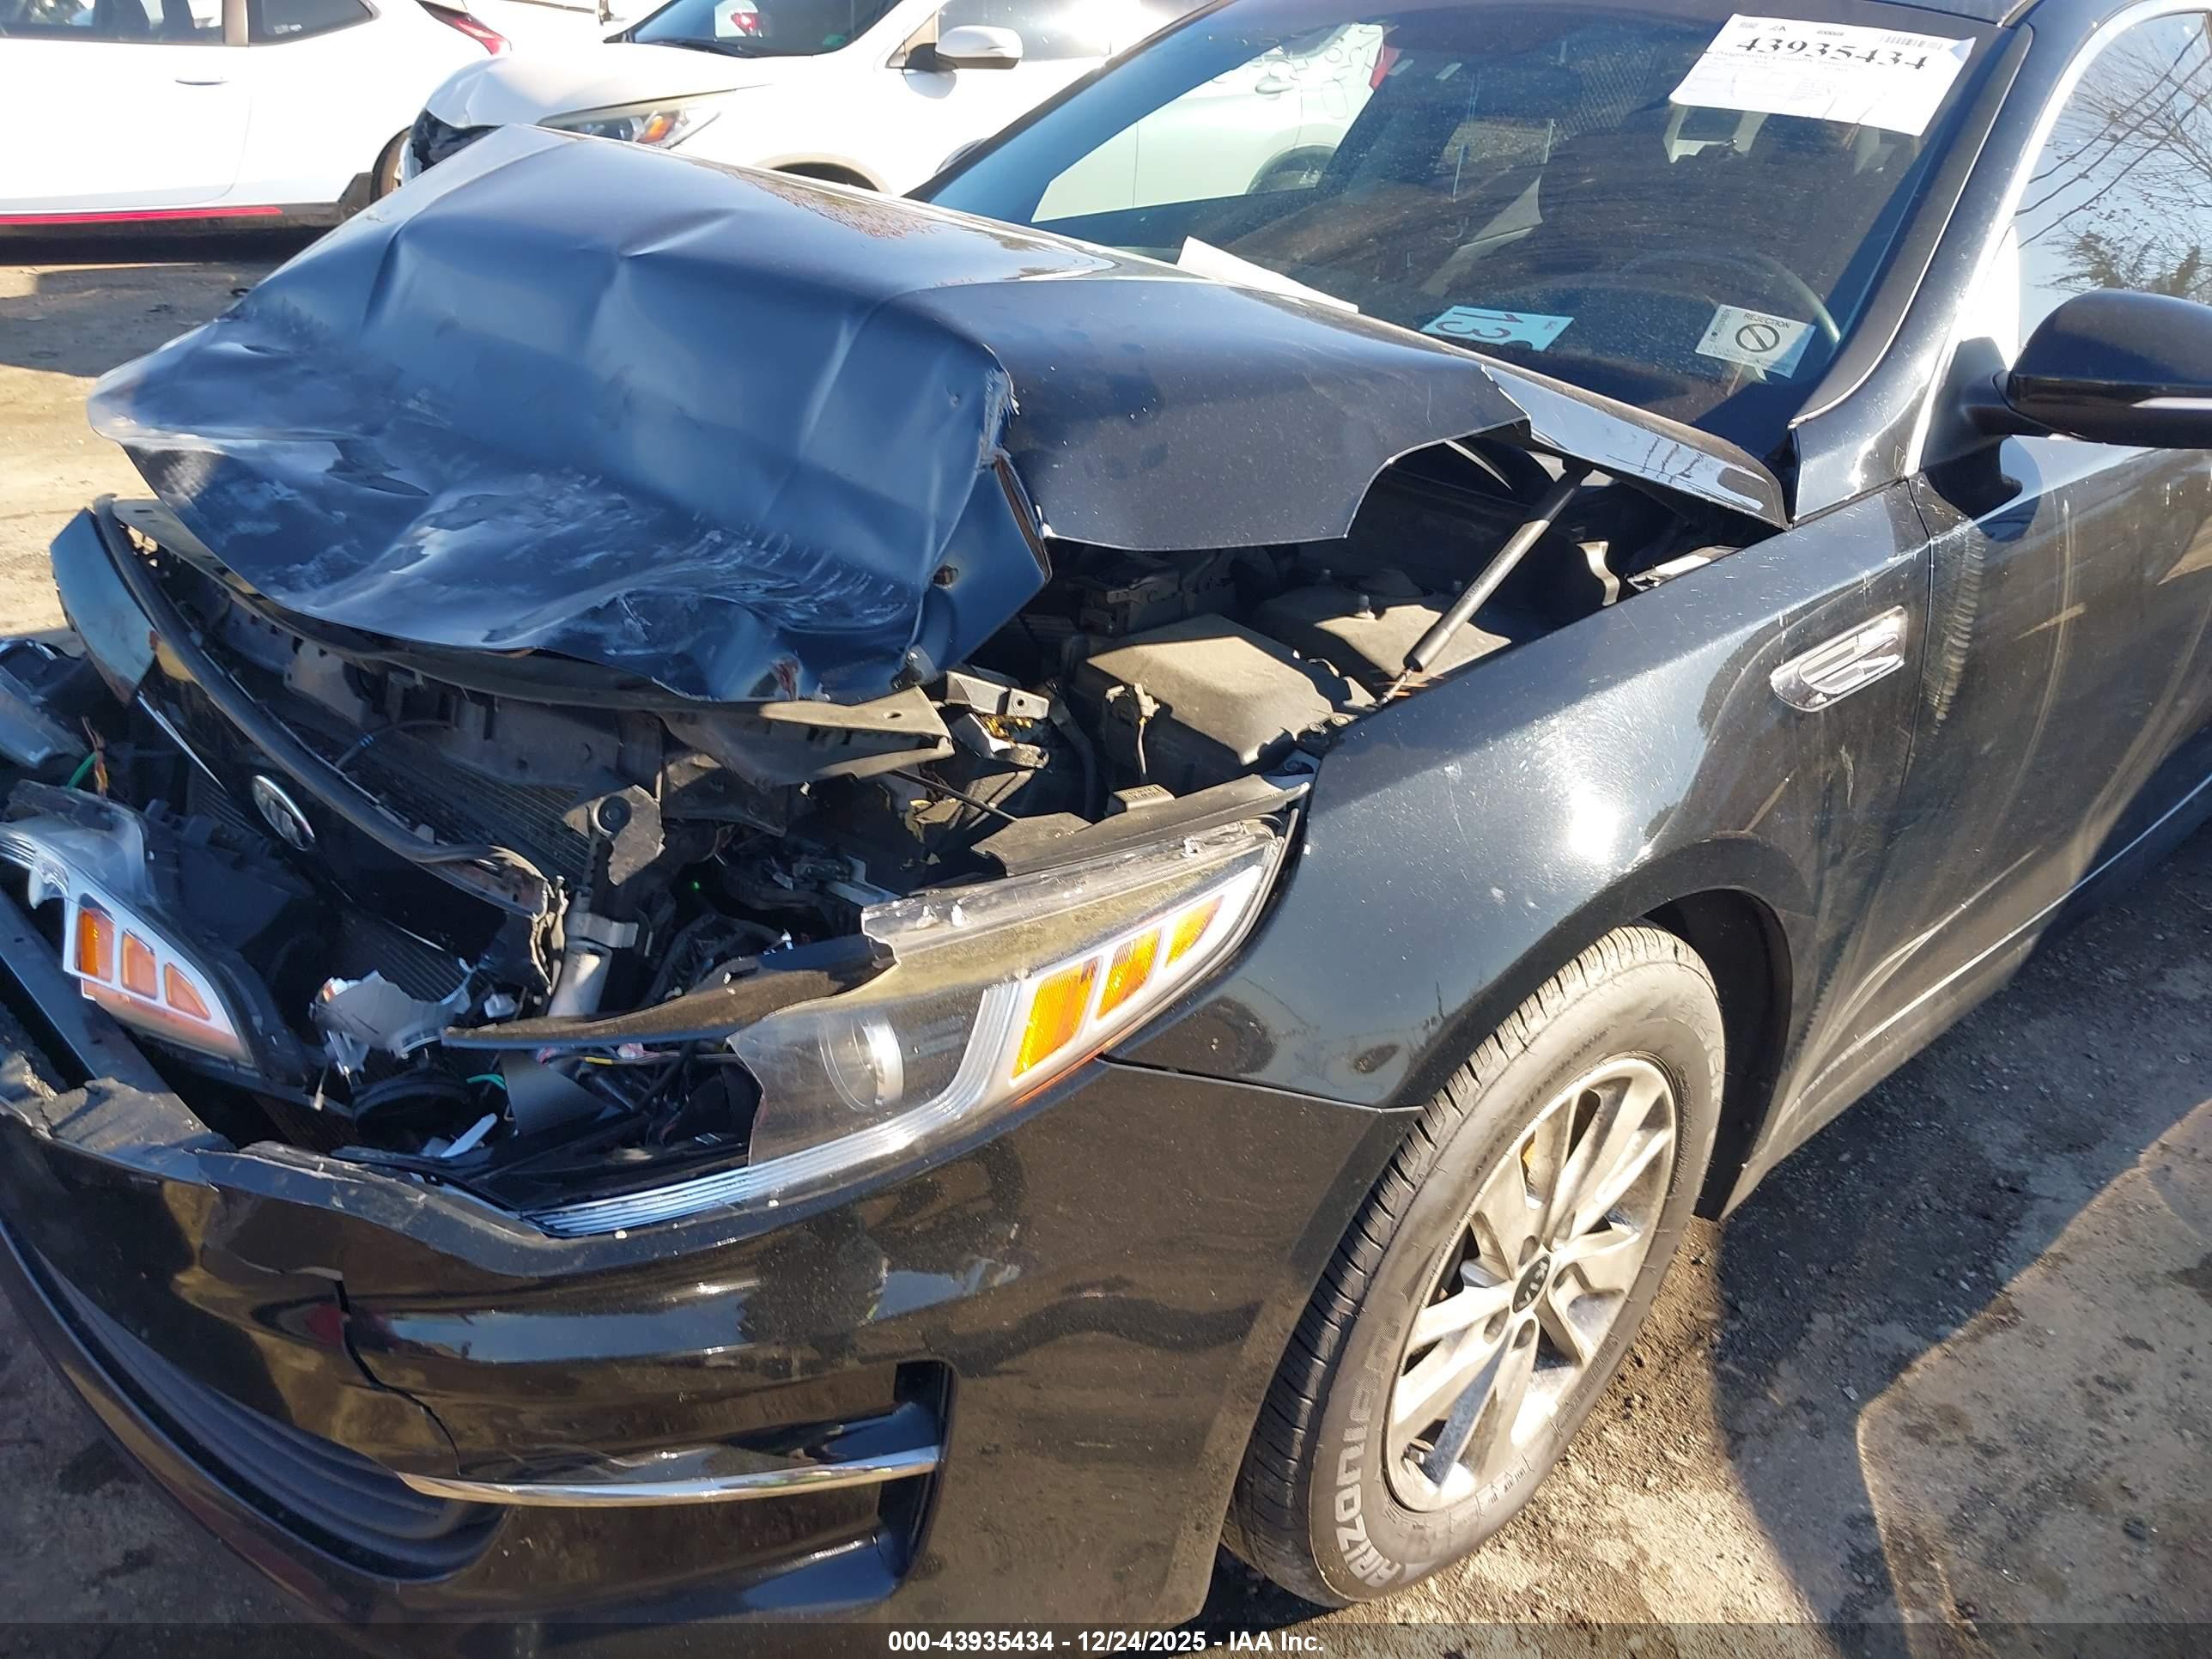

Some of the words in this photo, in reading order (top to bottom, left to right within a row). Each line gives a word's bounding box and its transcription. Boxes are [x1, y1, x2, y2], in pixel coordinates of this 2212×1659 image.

[1735, 36, 1929, 70] 43935434
[1743, 313, 1791, 329] REJECTION
[1516, 1260, 1549, 1310] KIA
